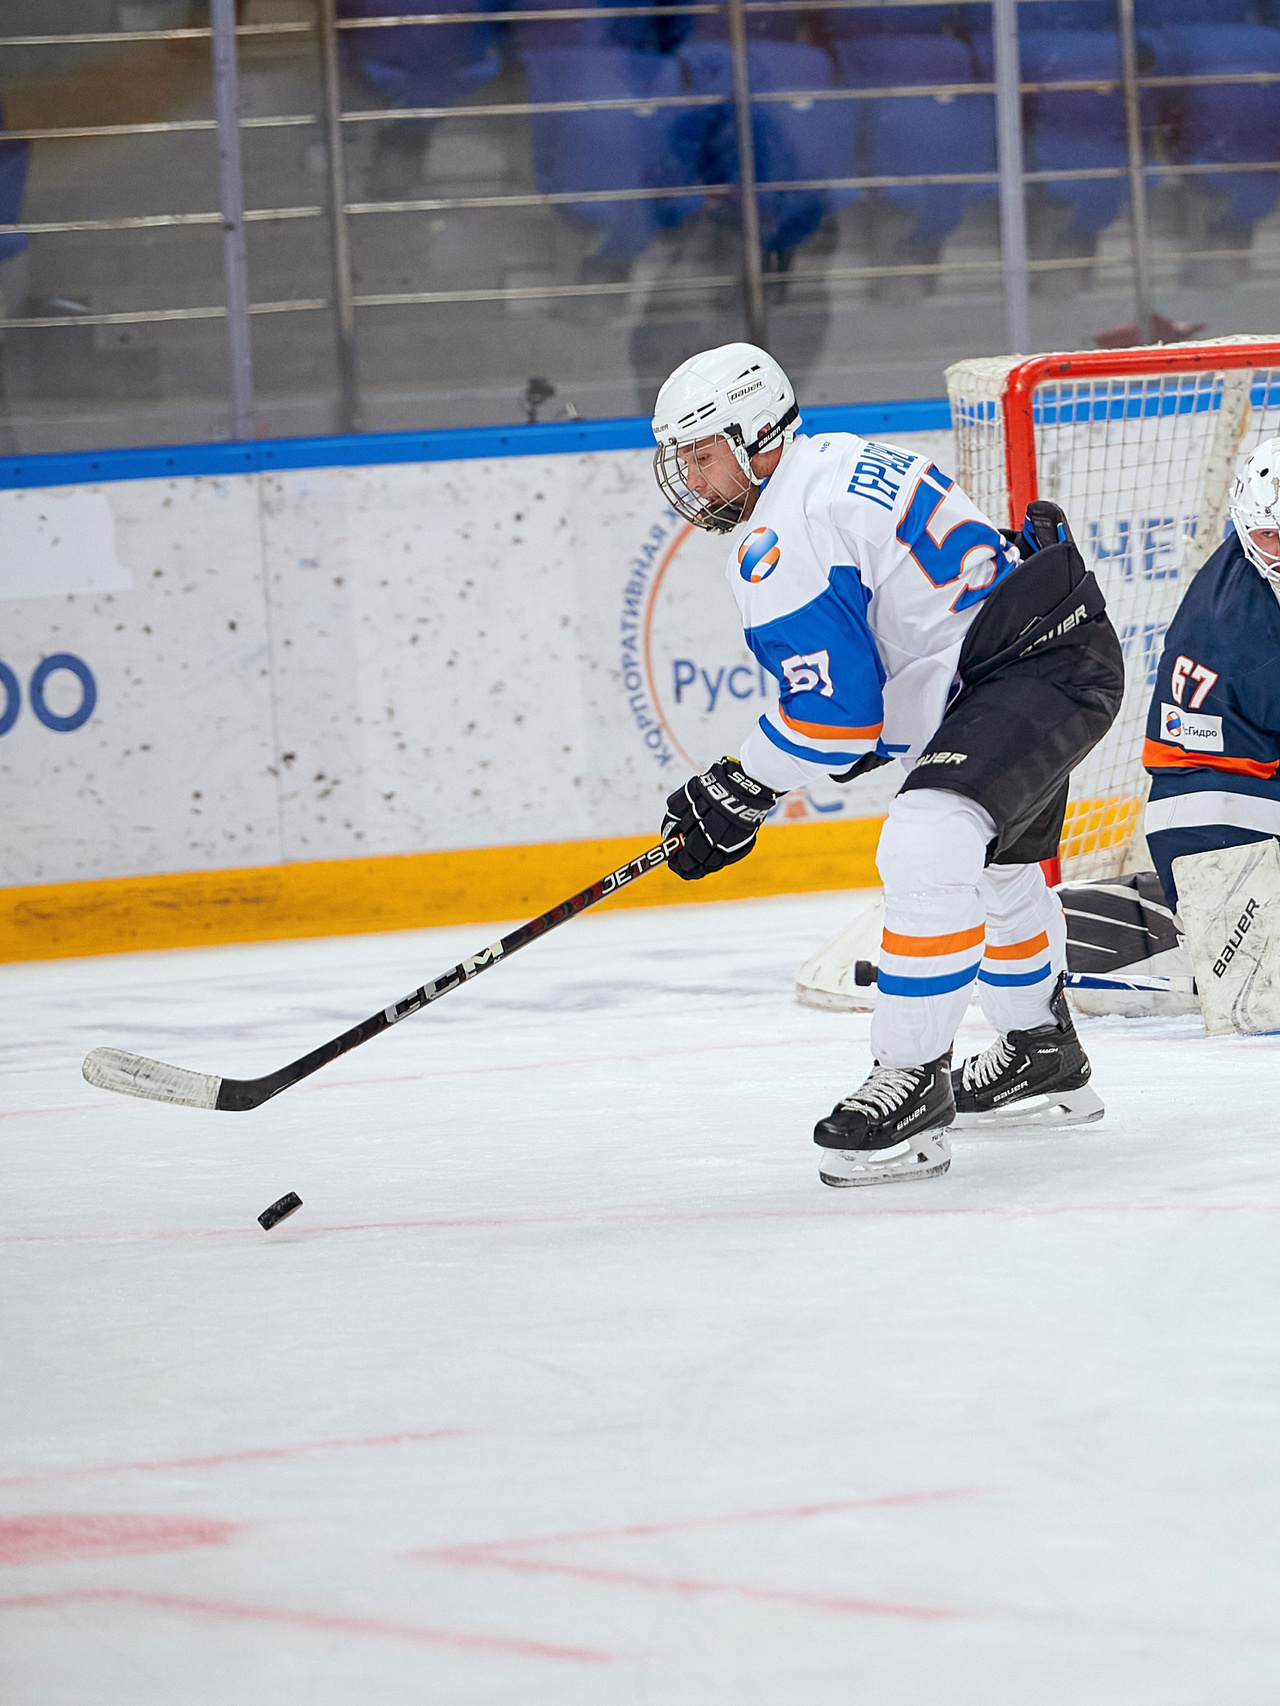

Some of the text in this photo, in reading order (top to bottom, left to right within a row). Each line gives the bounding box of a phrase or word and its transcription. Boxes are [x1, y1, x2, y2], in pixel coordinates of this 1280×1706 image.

[730, 380, 763, 401] BAUER
[758, 426, 782, 448] BAUER
[620, 521, 673, 768] КОРПОРАТИВНАЯ
[780, 649, 834, 697] 57
[1171, 655, 1219, 709] 67
[699, 771, 767, 823] BAUER
[727, 770, 762, 796] S29
[1212, 897, 1261, 979] BAUER
[384, 939, 505, 1024] CCM
[992, 1079, 1029, 1104] BAUER
[896, 1103, 927, 1132] BAUER
